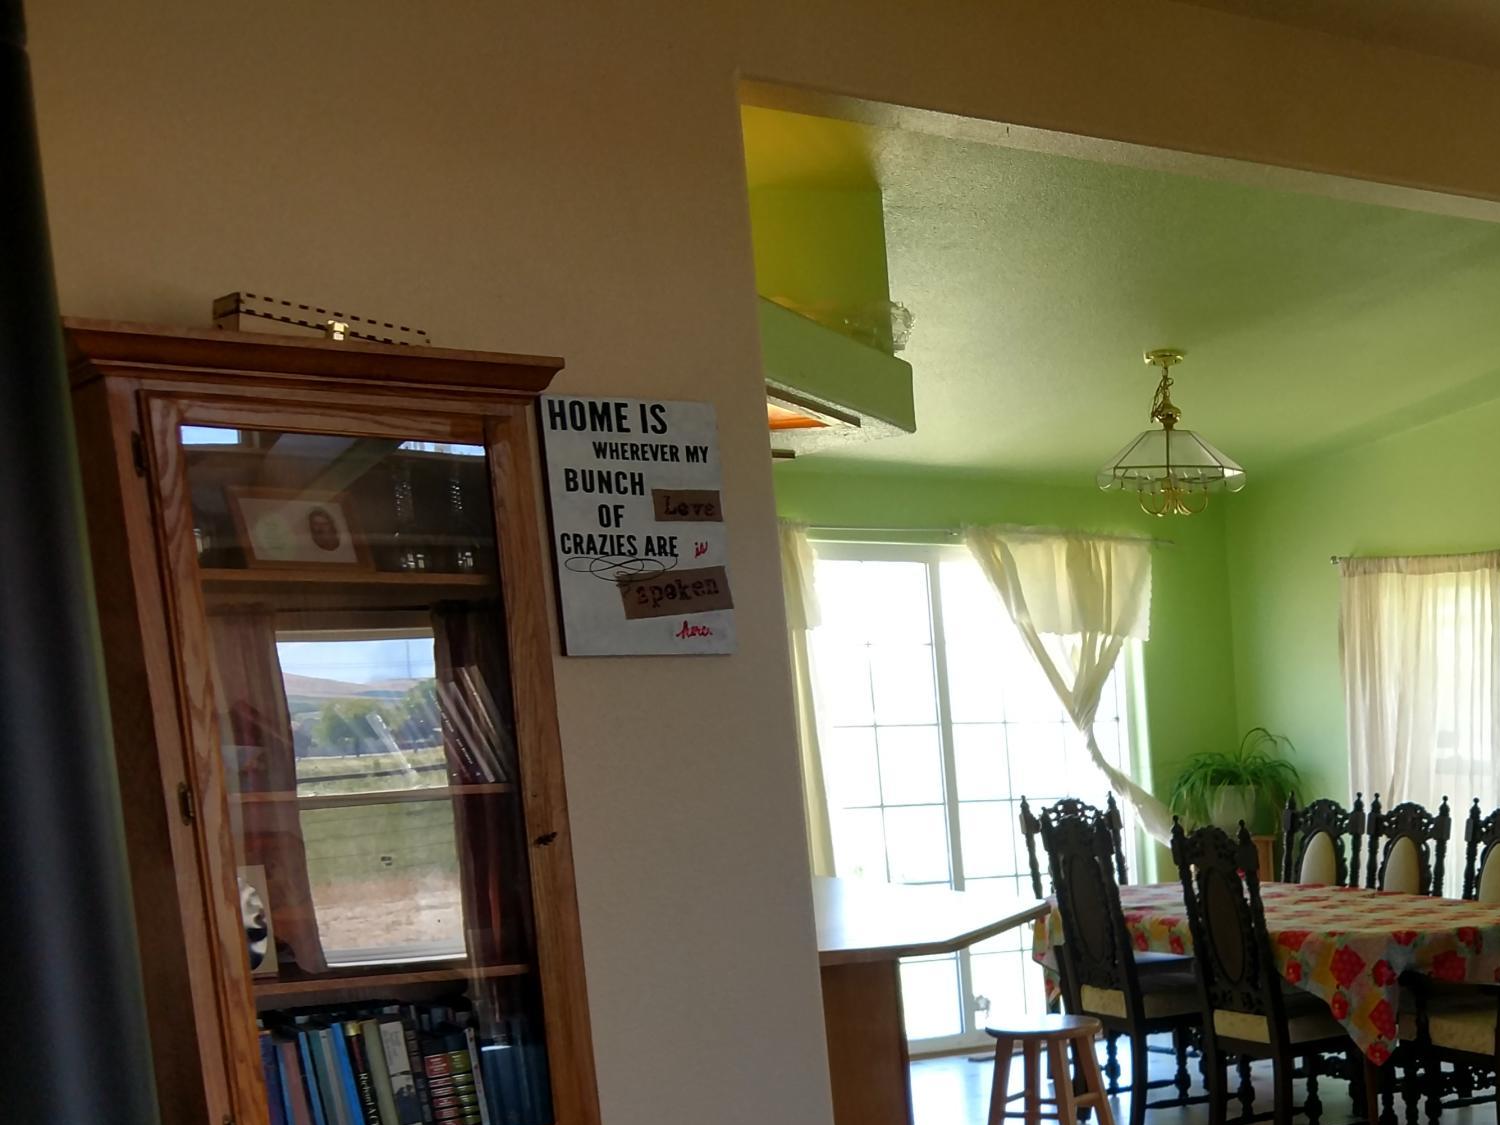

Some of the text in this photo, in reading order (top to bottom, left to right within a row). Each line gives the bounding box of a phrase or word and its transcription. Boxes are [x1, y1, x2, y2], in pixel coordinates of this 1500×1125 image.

[547, 399, 667, 434] HOME IS
[592, 441, 709, 463] WHEREVER MY
[564, 468, 645, 496] BUNCH
[597, 504, 625, 528] OF
[663, 495, 715, 517] Love
[560, 533, 679, 558] CRAZIES ARE
